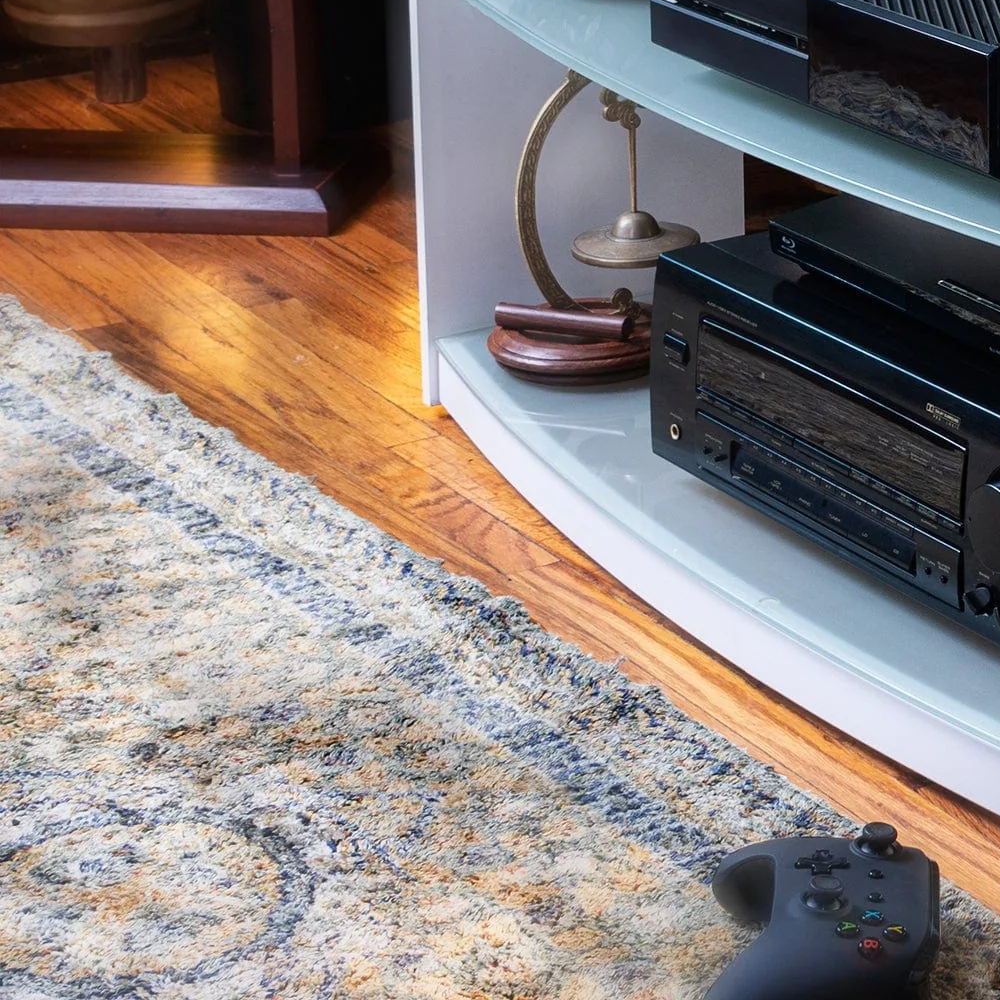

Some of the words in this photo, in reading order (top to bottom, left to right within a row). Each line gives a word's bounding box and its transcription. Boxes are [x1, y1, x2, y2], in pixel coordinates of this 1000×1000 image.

[864, 910, 881, 919] X
[841, 921, 857, 931] A
[886, 926, 903, 934] Y
[863, 939, 879, 949] B
